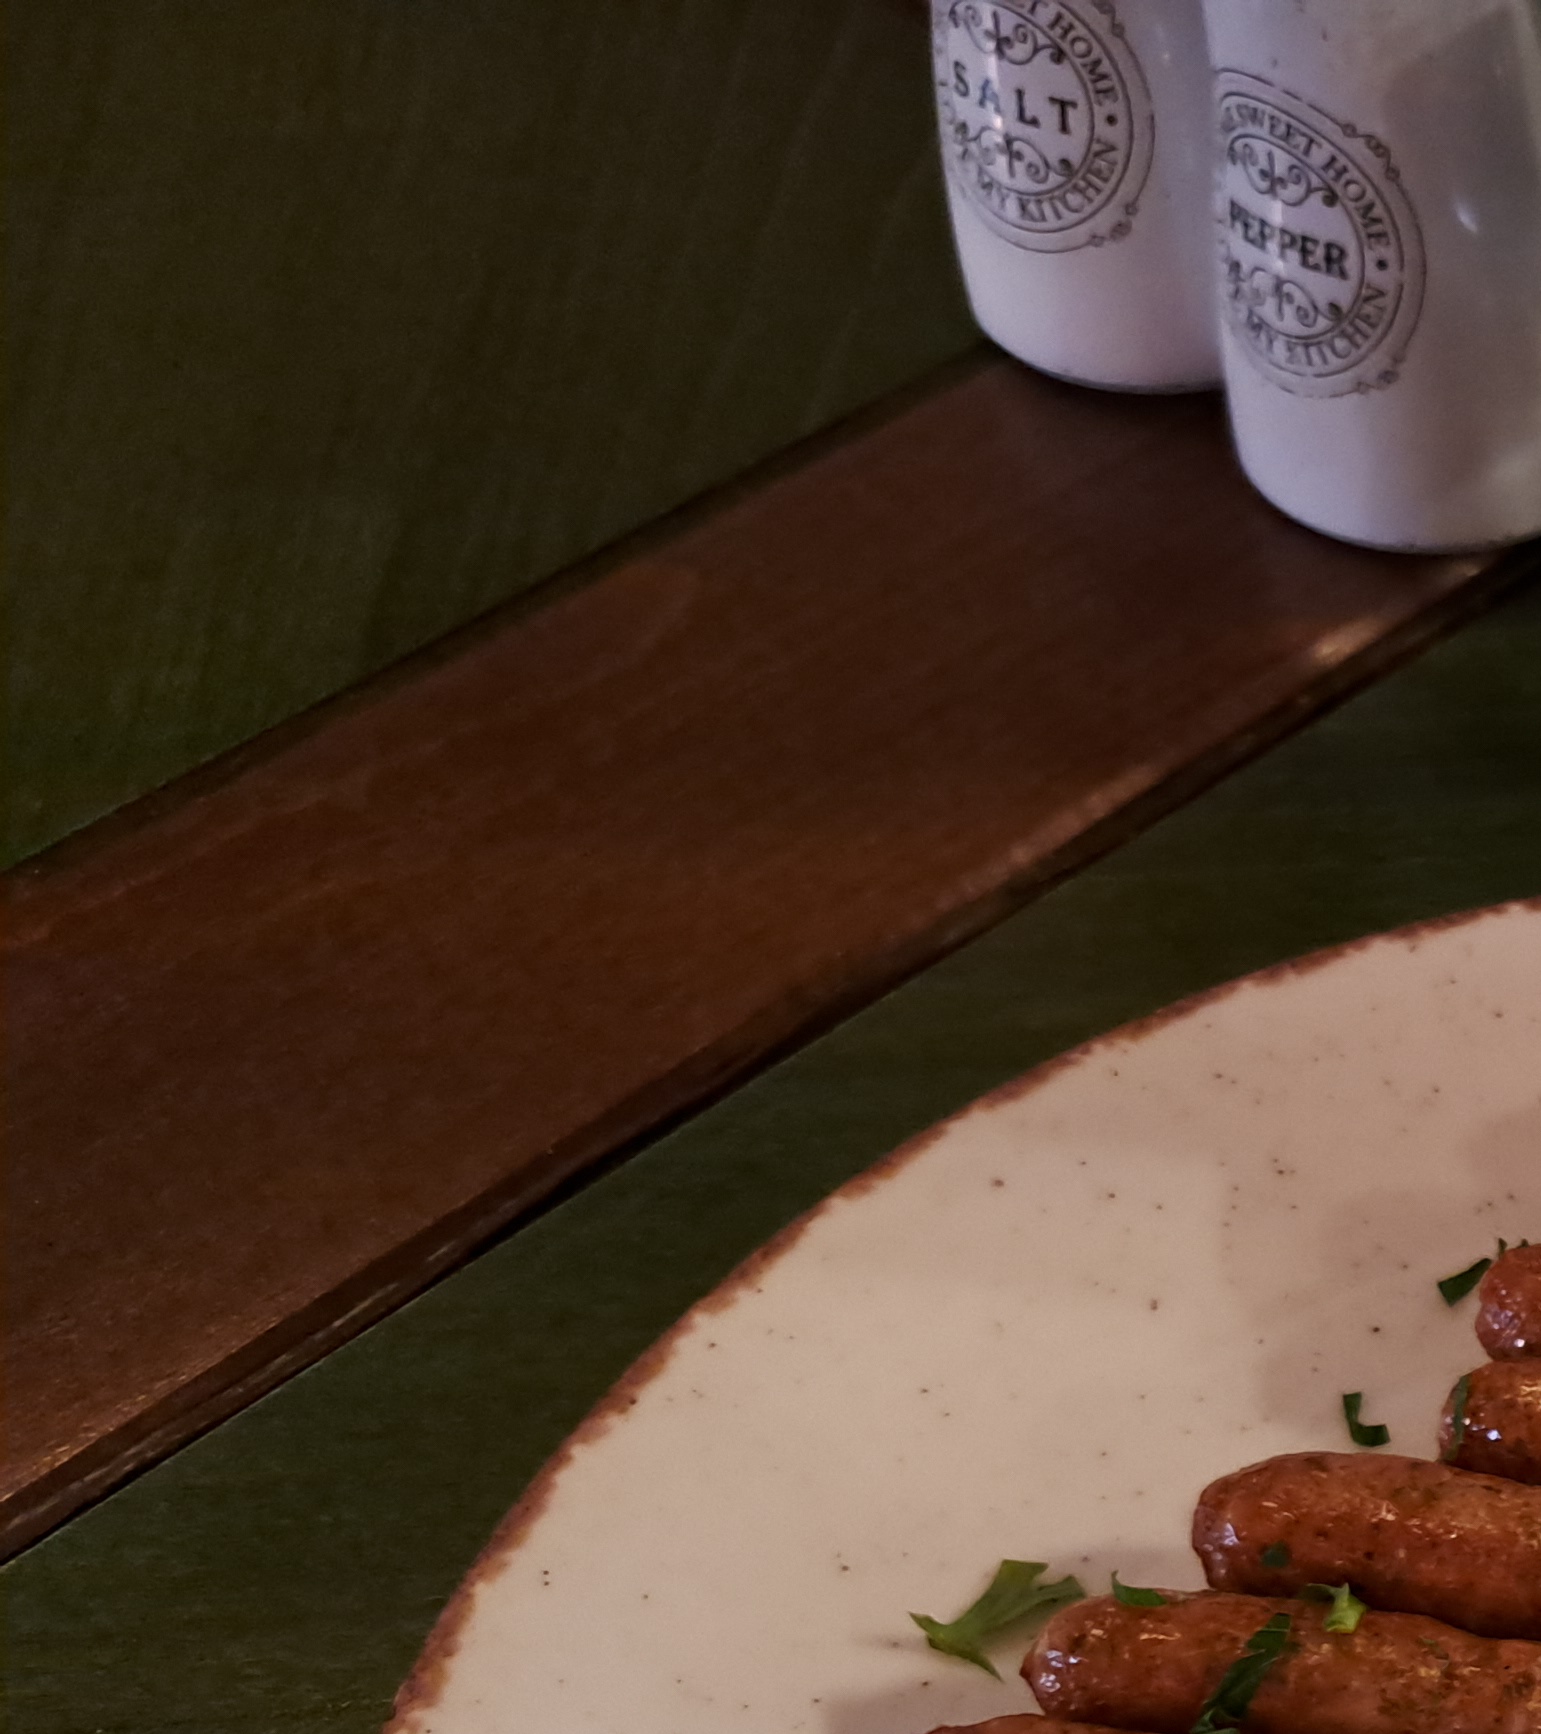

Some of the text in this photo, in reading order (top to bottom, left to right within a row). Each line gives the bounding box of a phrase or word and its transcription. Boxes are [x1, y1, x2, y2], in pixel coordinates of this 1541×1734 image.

[953, 60, 1079, 135] SALT
[1229, 199, 1349, 282] PEPPER
[1320, 154, 1391, 250] HOME
